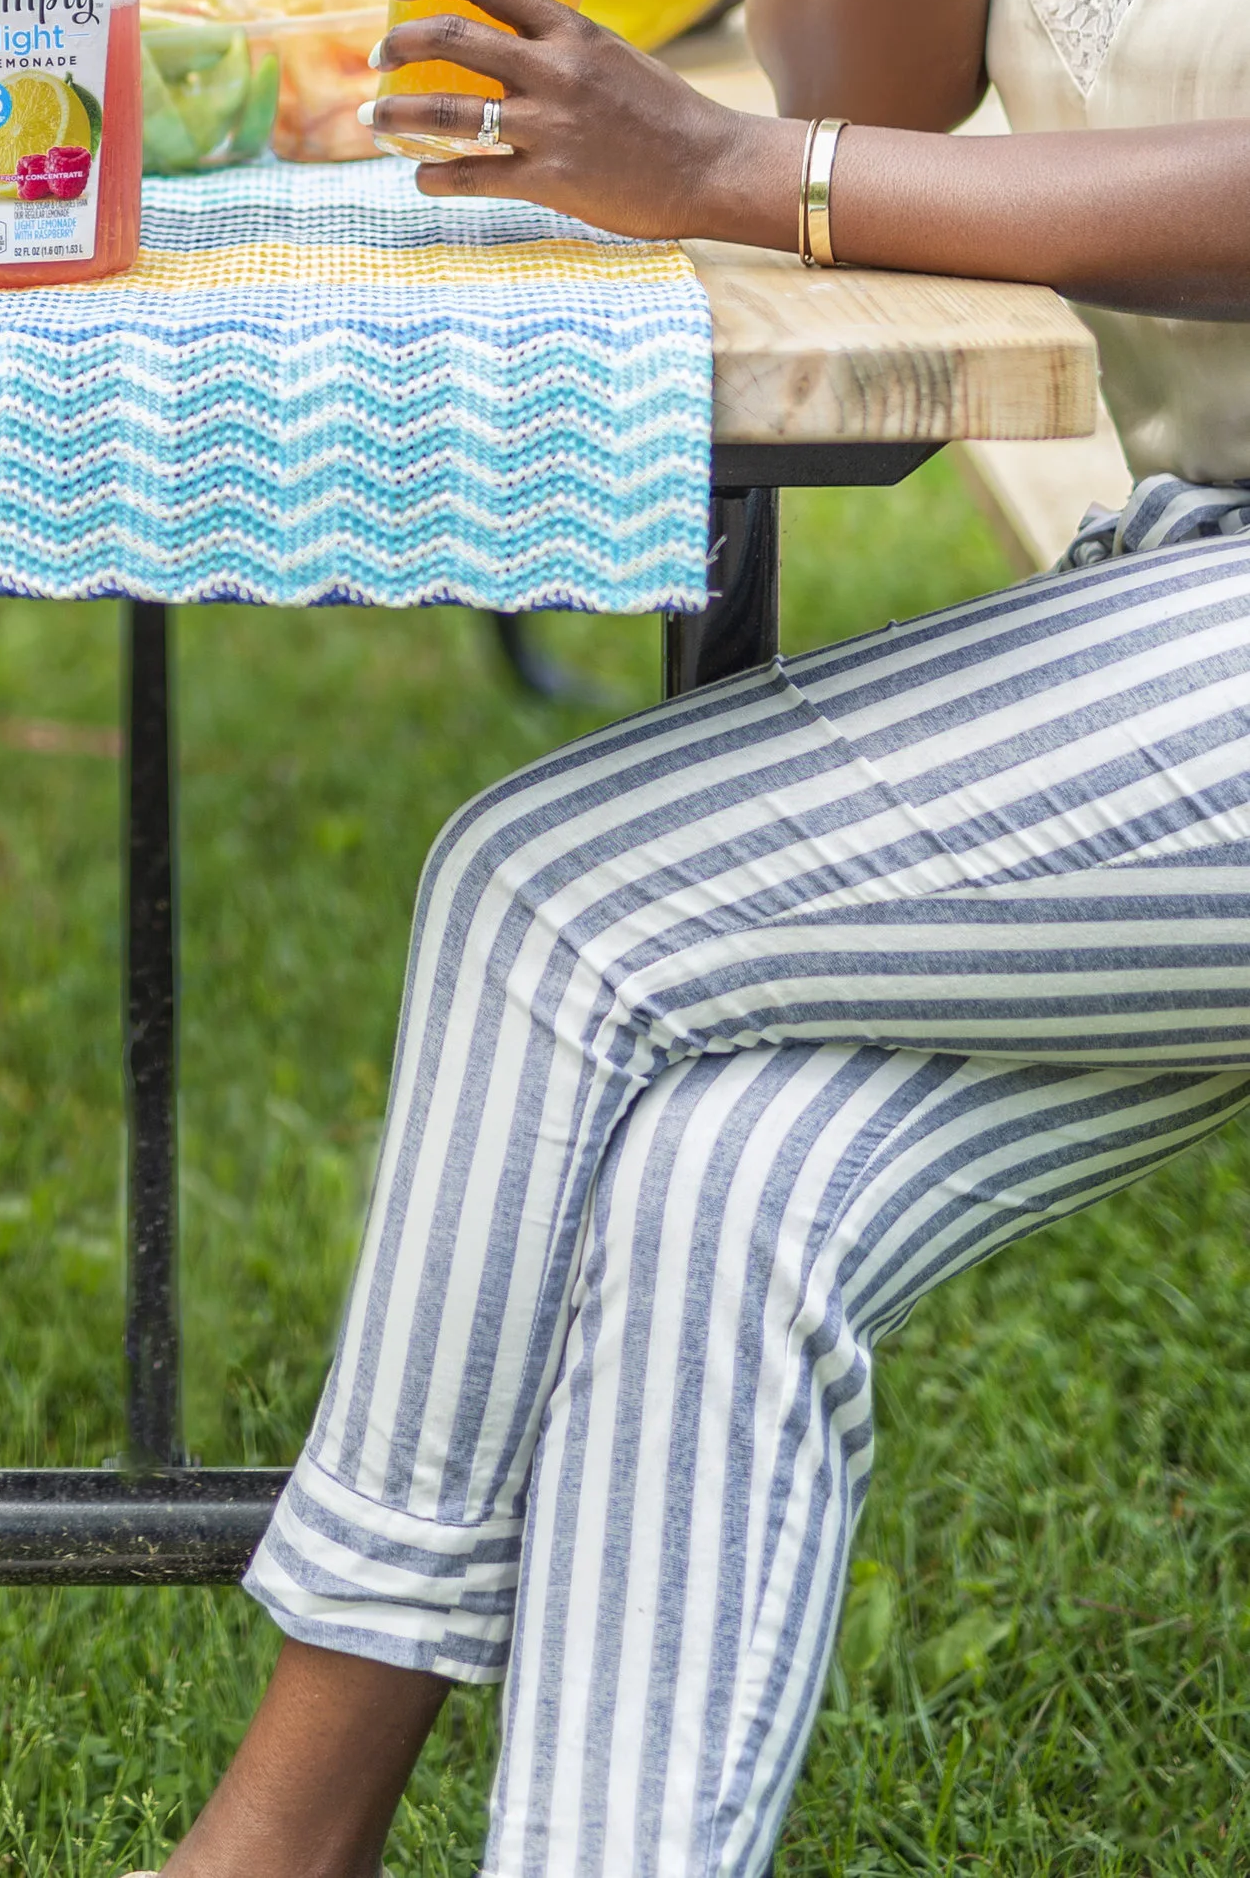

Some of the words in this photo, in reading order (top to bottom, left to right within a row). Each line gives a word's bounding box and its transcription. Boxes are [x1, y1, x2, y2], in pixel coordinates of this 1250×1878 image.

[0, 174, 24, 182] FROM
[25, 171, 83, 181] CONCENTRATE
[46, 209, 70, 218] LEMONADE
[14, 220, 34, 230] LIGHT
[38, 218, 77, 229] LEMONADE
[14, 231, 32, 240] WITH
[35, 228, 74, 239] RASPBERRY
[14, 248, 22, 256] 52
[23, 247, 30, 256] FL
[32, 247, 40, 255] OZ
[41, 246, 53, 257] (1.6
[54, 246, 64, 256] QT)
[66, 245, 78, 254] 1.53
[79, 245, 83, 253] L
